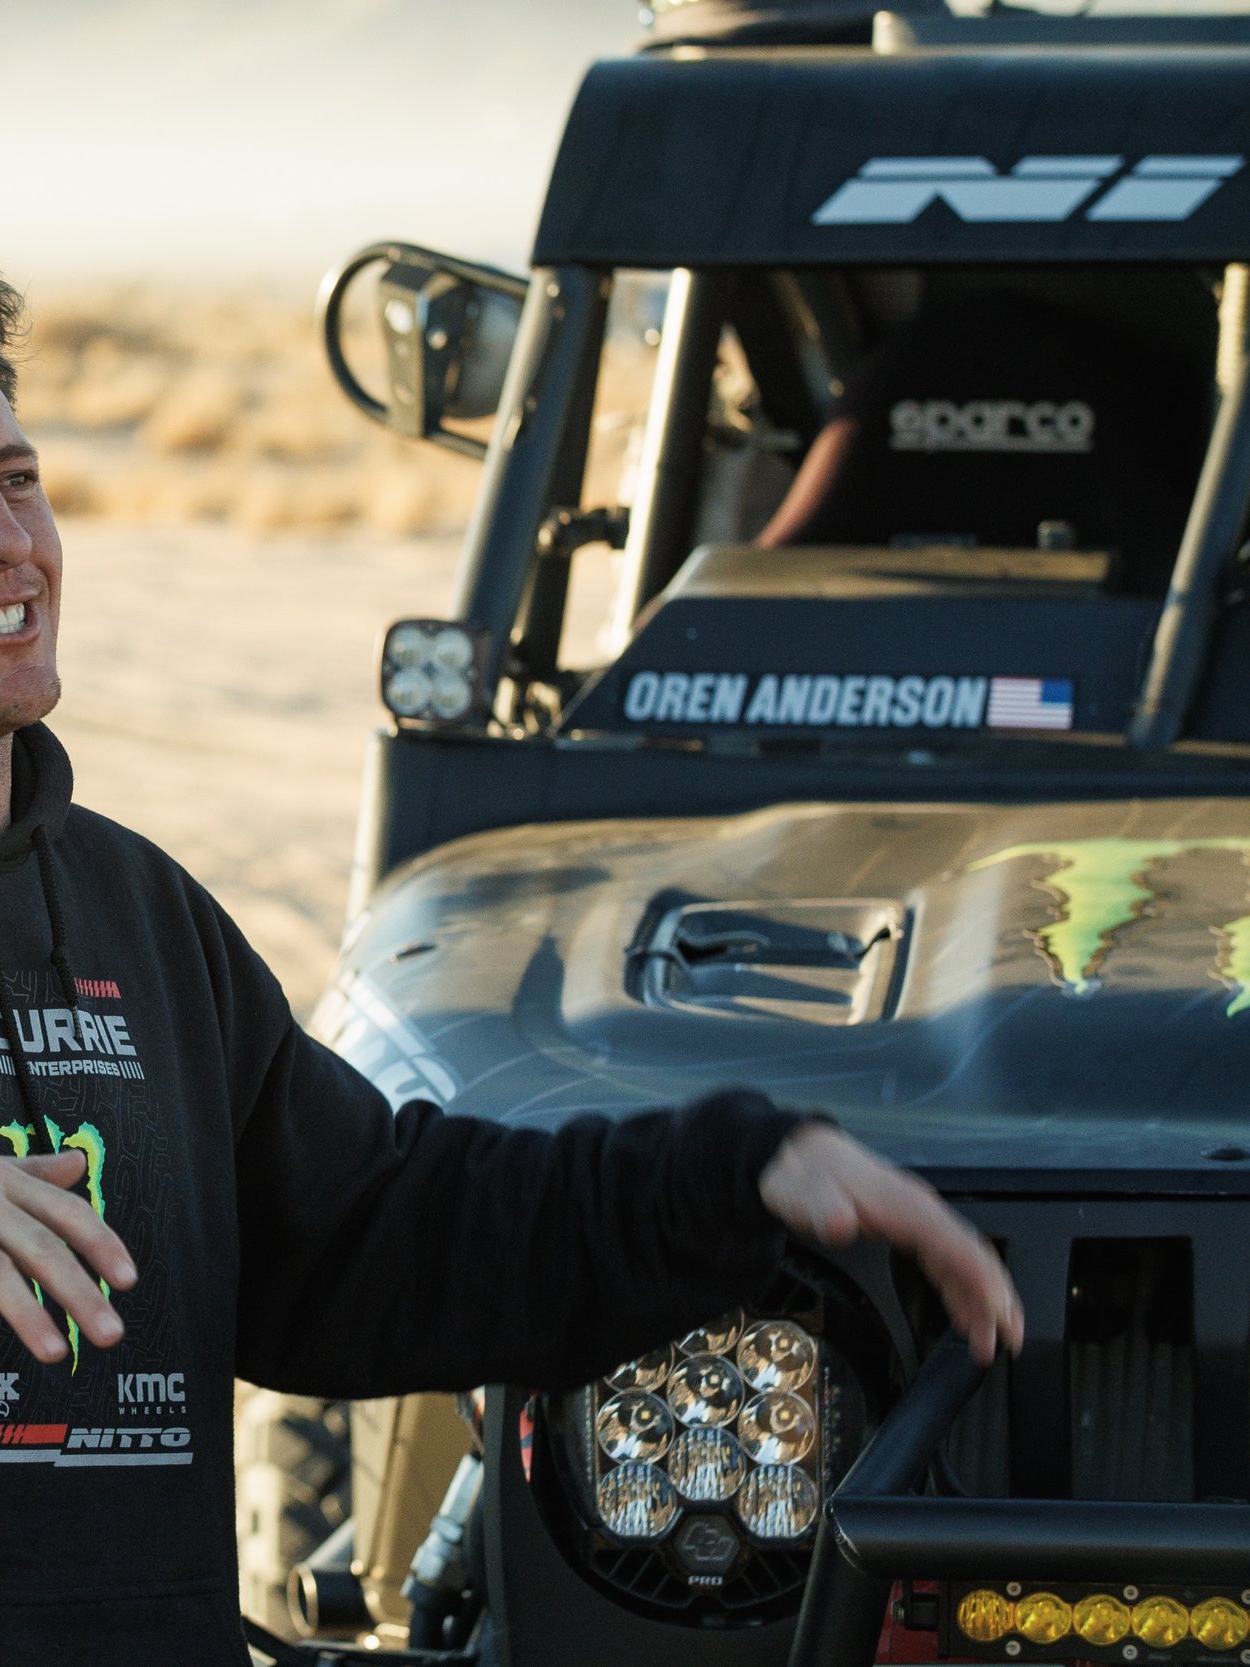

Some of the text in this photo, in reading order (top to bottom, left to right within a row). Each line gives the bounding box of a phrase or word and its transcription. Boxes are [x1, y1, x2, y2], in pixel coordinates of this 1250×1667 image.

[888, 400, 1095, 452] sparco
[624, 671, 986, 728] OREN ANDERSON
[117, 1372, 186, 1403] KMC
[118, 1406, 187, 1415] WHEELS
[66, 1427, 191, 1449] NITTO
[688, 1575, 724, 1586] PRO
